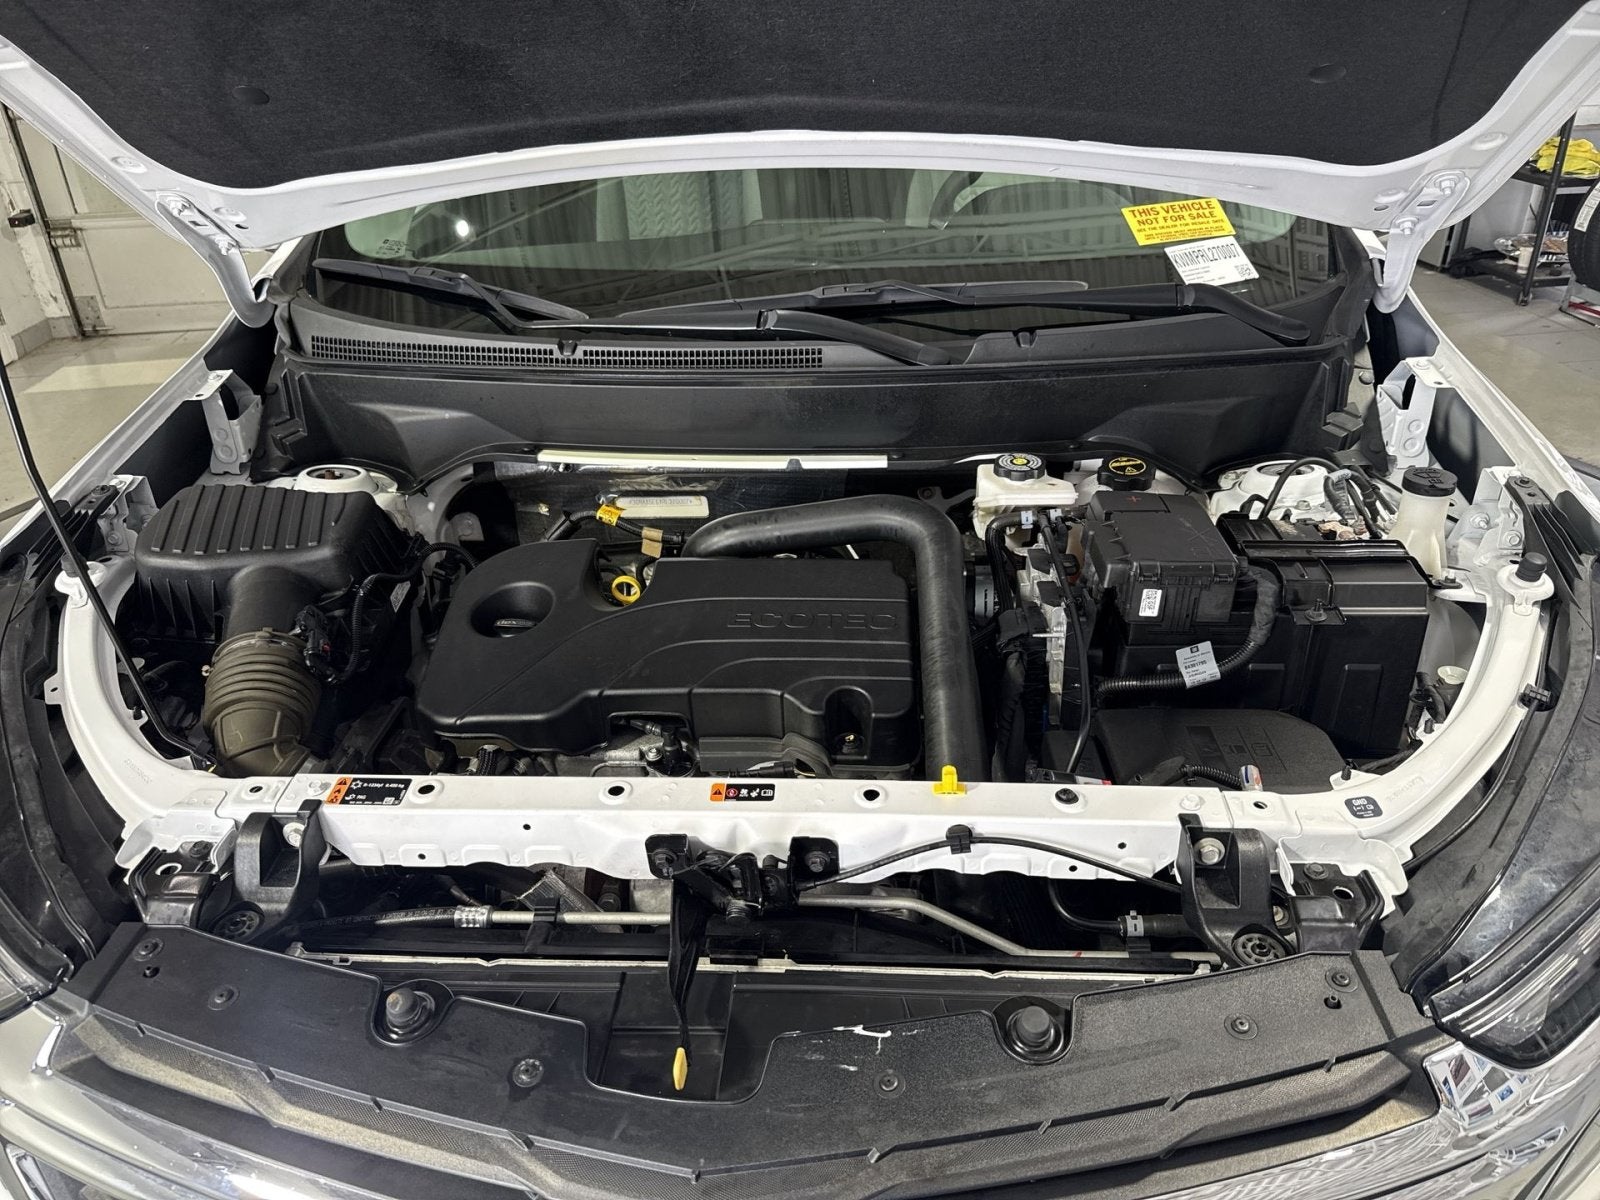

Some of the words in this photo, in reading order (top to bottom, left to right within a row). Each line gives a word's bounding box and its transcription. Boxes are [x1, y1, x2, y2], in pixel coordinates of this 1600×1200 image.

[1129, 207, 1160, 218] THIS
[1160, 201, 1215, 214] VEHICLE
[1137, 217, 1160, 226] NOT
[1163, 215, 1186, 223] FOR
[1188, 211, 1217, 220] SALE
[728, 613, 896, 629] ECOTEC
